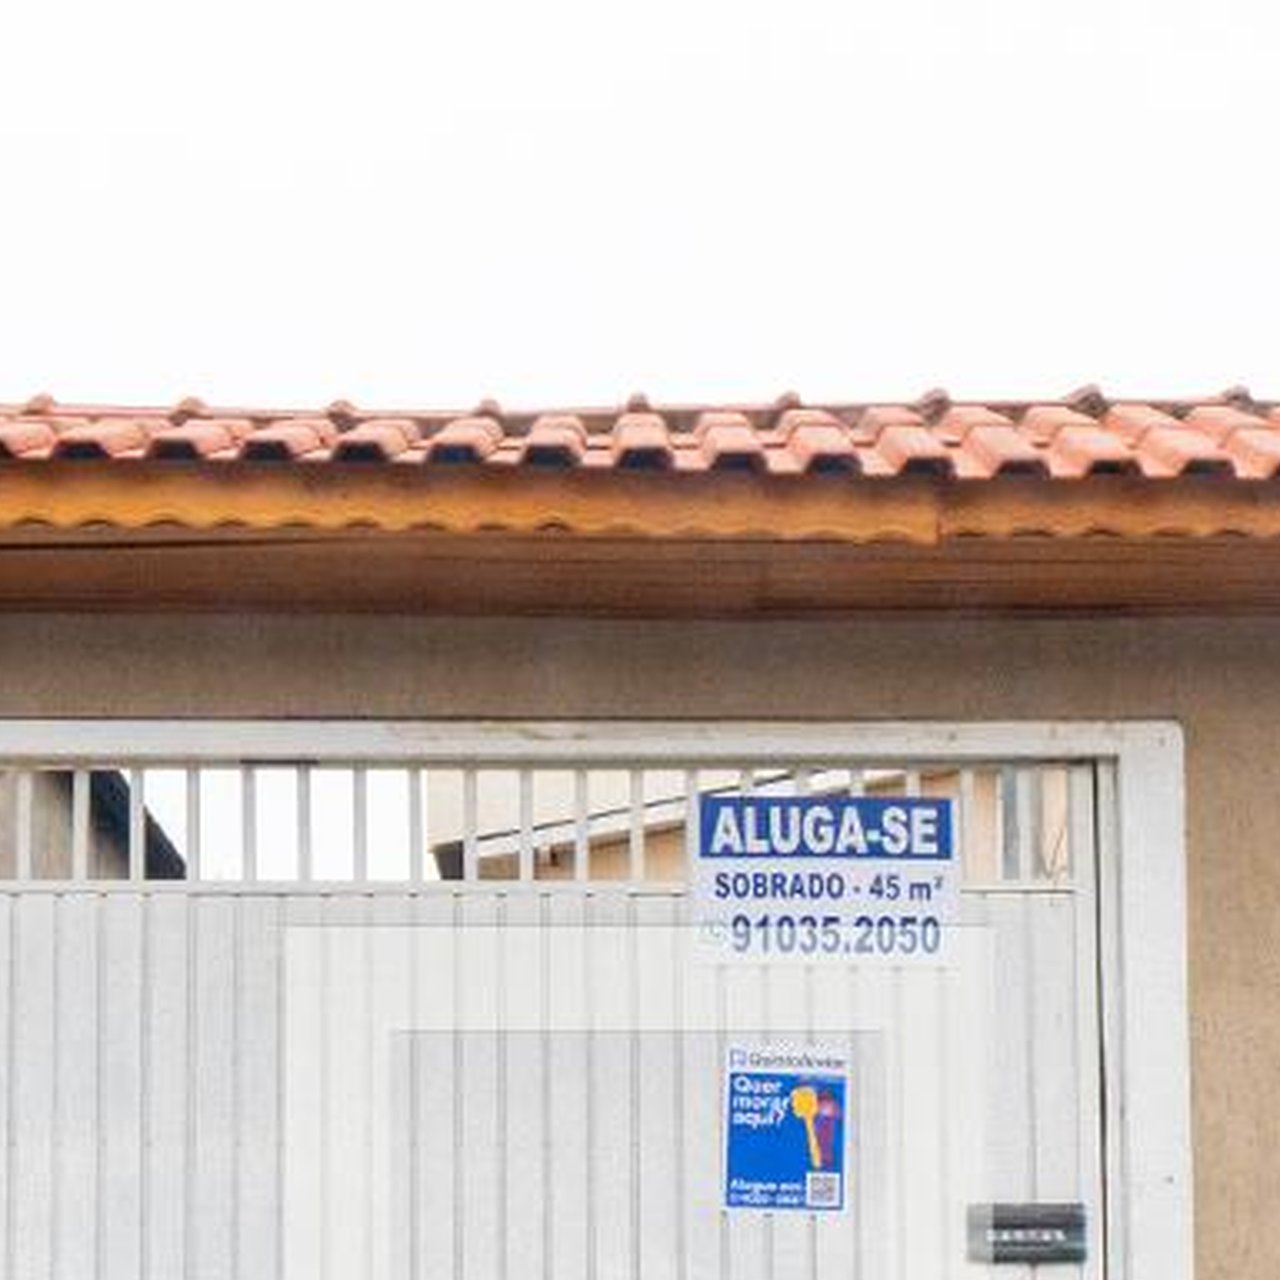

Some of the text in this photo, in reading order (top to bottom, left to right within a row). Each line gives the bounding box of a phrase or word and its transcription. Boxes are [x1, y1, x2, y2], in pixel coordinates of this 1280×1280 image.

[709, 805, 939, 855] ALUGA-SE
[714, 872, 845, 900] SOBRADO
[869, 874, 901, 900] 45
[731, 914, 941, 954] 91035.2050
[733, 1076, 784, 1093] Quer
